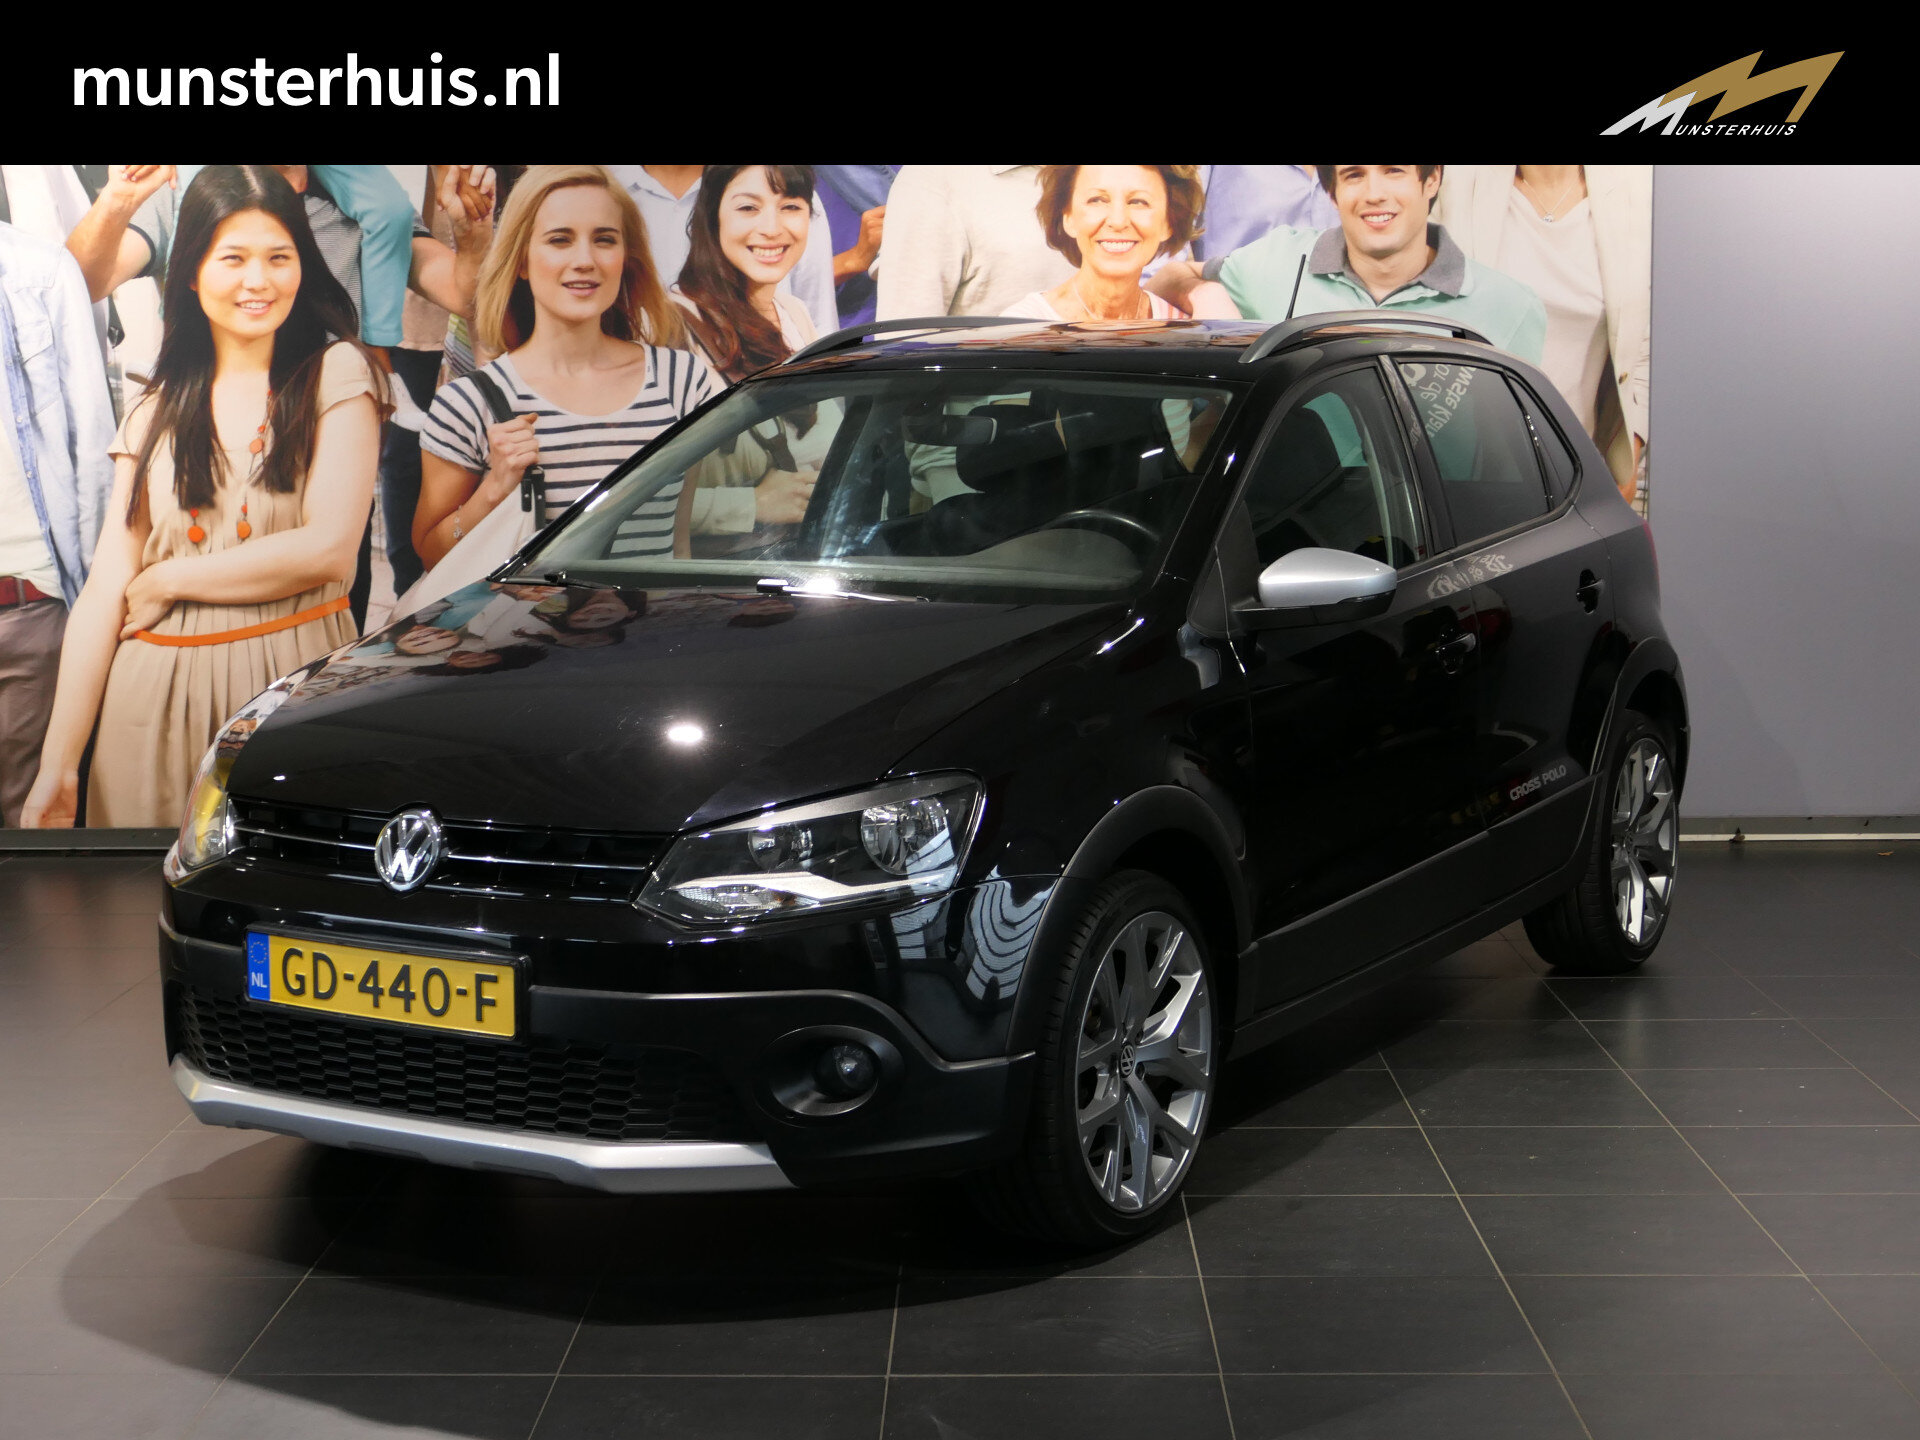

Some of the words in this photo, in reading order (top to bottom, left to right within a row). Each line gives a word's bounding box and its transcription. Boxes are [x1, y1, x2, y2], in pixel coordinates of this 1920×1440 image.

[1509, 776, 1542, 801] CROSS
[1541, 764, 1567, 785] POLO
[251, 971, 268, 989] NL
[281, 947, 498, 1022] GD-440-F
